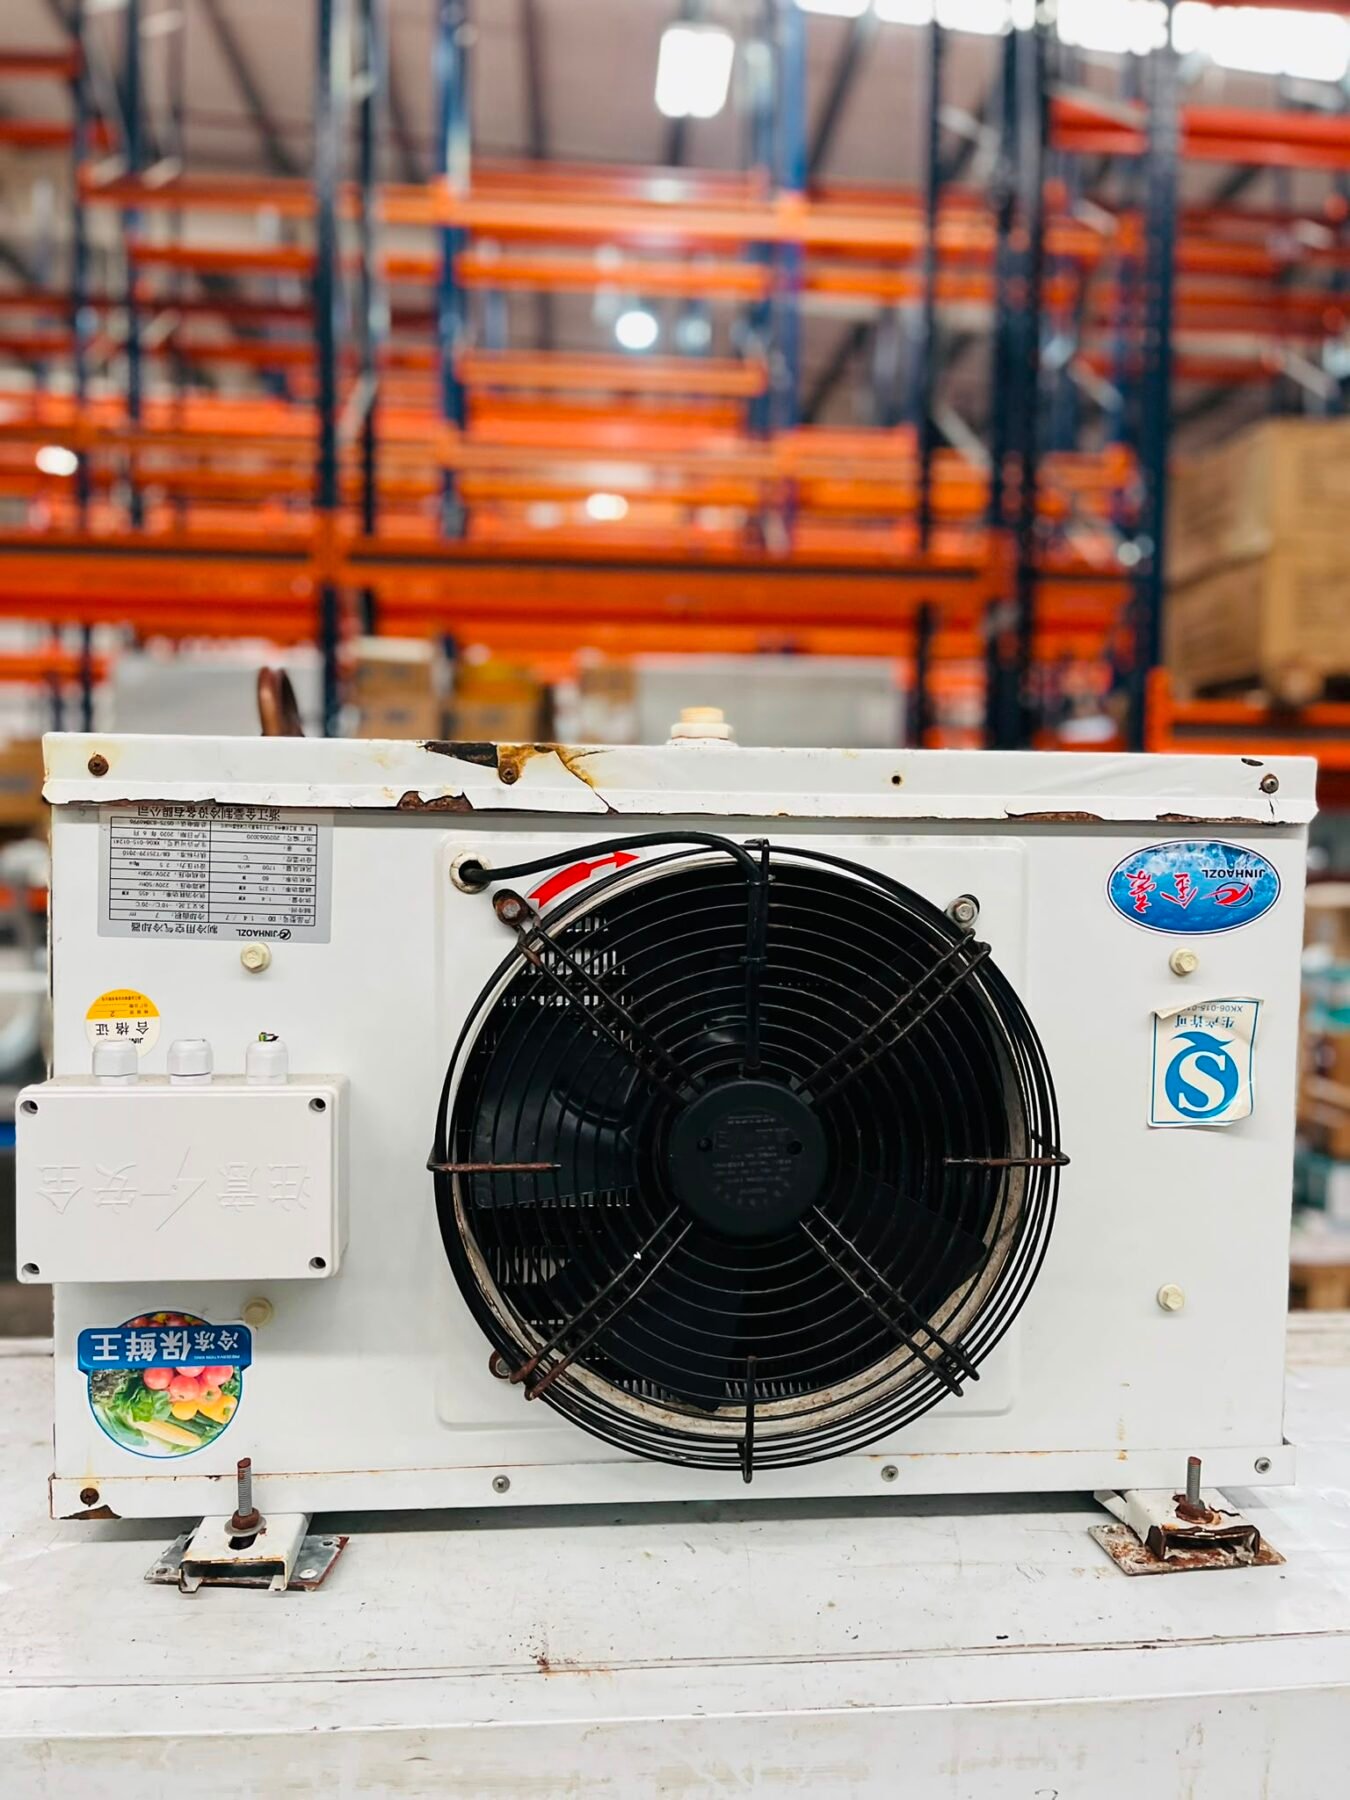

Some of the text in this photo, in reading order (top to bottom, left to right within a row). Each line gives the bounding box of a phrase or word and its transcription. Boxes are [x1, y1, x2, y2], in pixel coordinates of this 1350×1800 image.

[137, 805, 281, 822] 浙江金豪制冷设备有限公司
[1201, 868, 1266, 880] JINHAOZL
[130, 922, 218, 934] 制冷用空气冷却器
[235, 929, 278, 938] JINHAOZL
[95, 1021, 149, 1036] 合格证
[1175, 1014, 1235, 1029] 生产许可
[34, 1160, 313, 1216] 注意 安全
[90, 1329, 239, 1362] 冷冻保鲜王
